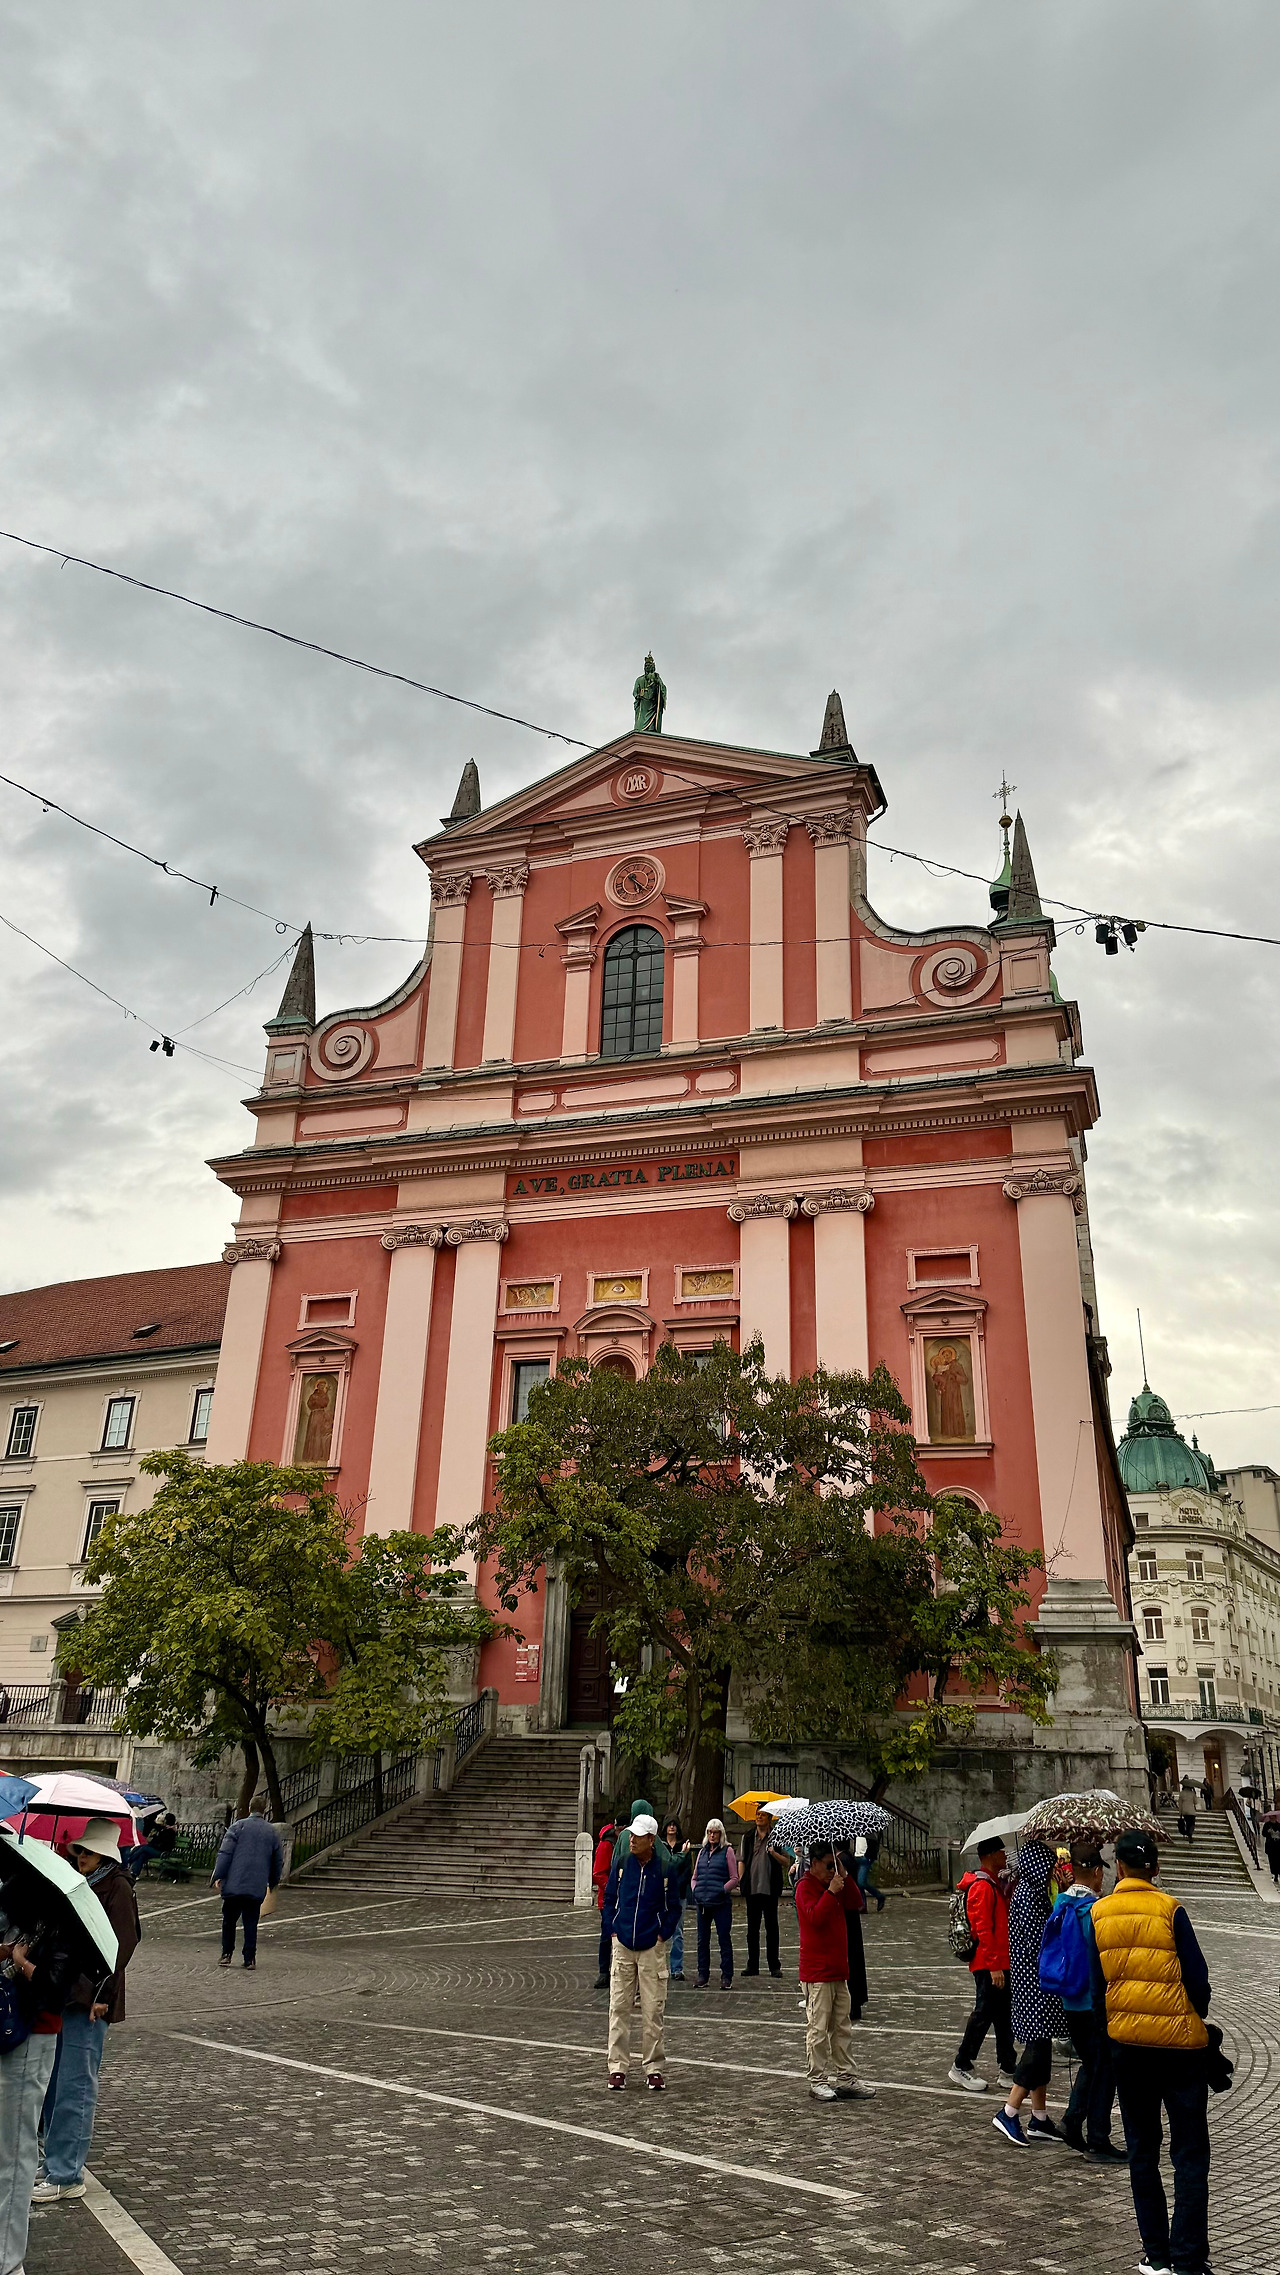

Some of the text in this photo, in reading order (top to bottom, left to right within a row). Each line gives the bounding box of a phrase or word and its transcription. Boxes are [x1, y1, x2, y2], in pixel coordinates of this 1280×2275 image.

[568, 1168, 649, 1190] GRATIA
[658, 1160, 735, 1182] PLENA!
[1179, 1507, 1201, 1516] HOTEL
[1178, 1515, 1203, 1524] UNION
